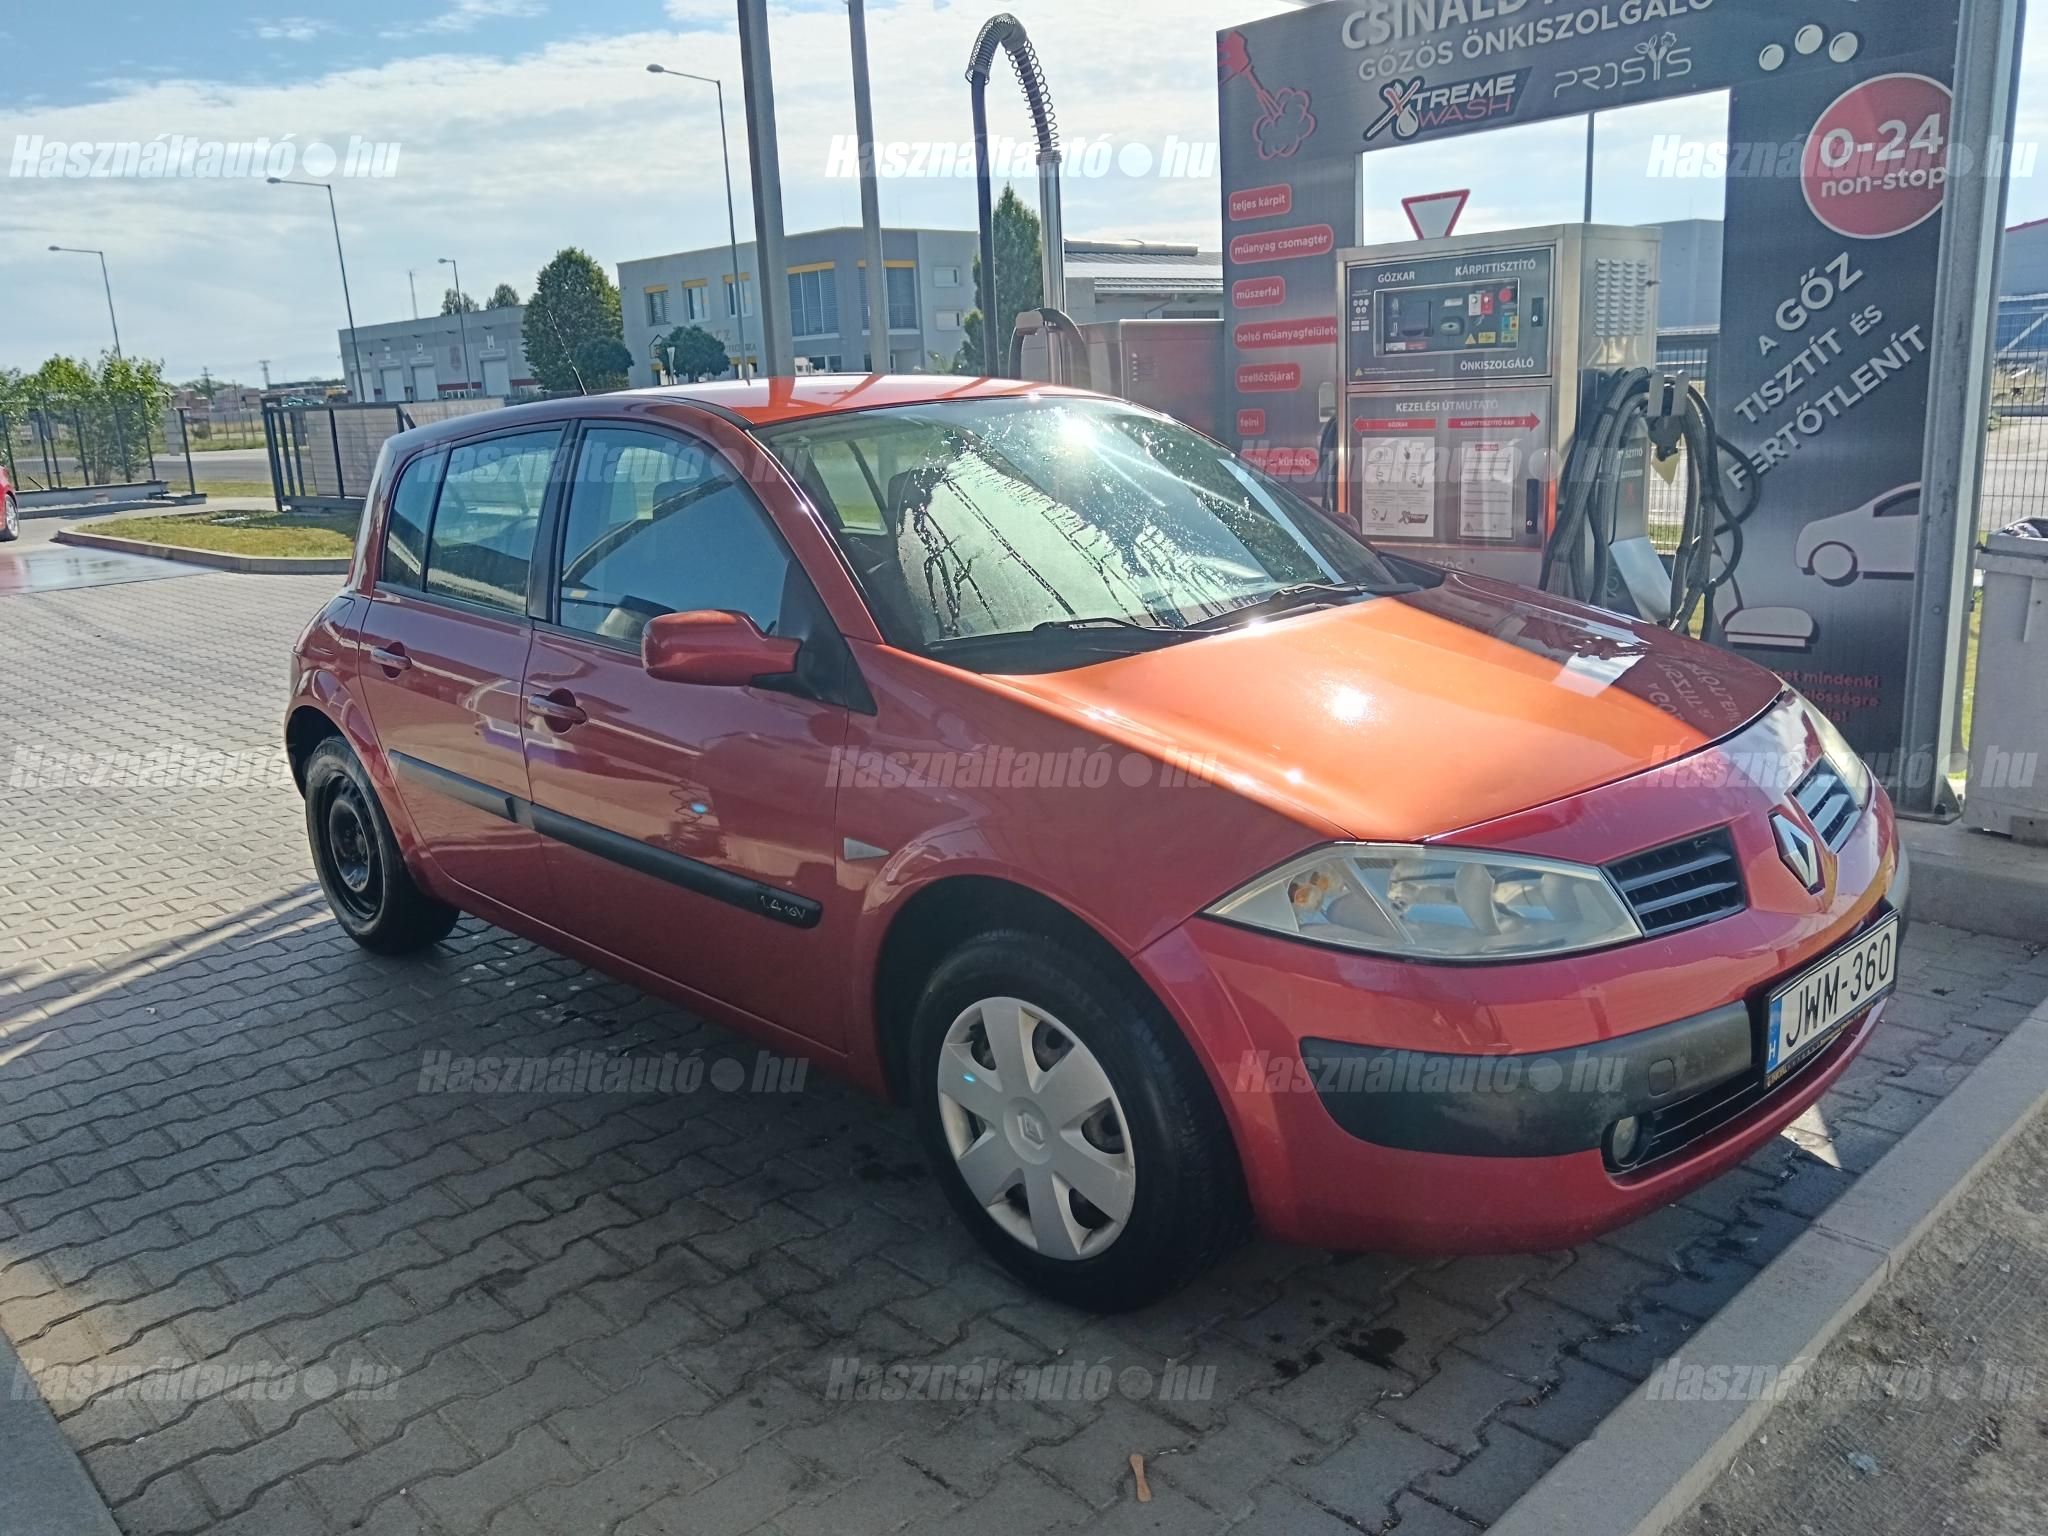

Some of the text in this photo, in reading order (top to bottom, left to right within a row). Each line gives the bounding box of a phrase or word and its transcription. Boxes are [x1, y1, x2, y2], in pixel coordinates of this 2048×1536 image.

[1359, 40, 1453, 81] GŐZÖS
[1419, 95, 1511, 127] WASH
[1819, 113, 1944, 168] 0-24
[1821, 166, 1947, 198] non-stop
[1232, 194, 1286, 212] teljes kárpit
[1235, 234, 1328, 255] műanyag csomagtér
[1377, 271, 1416, 283] GŐZKAR
[1236, 286, 1280, 300] műszerfal
[1758, 251, 1864, 356] A GŐZ
[1237, 331, 1261, 342] belső
[1460, 357, 1535, 371] ÖNKISZOLGÁLÓ
[1734, 304, 1884, 424] TISZTÍT ÉS
[1395, 401, 1440, 412] KEZELÉSI
[1786, 932, 1891, 1048] JWM-360
